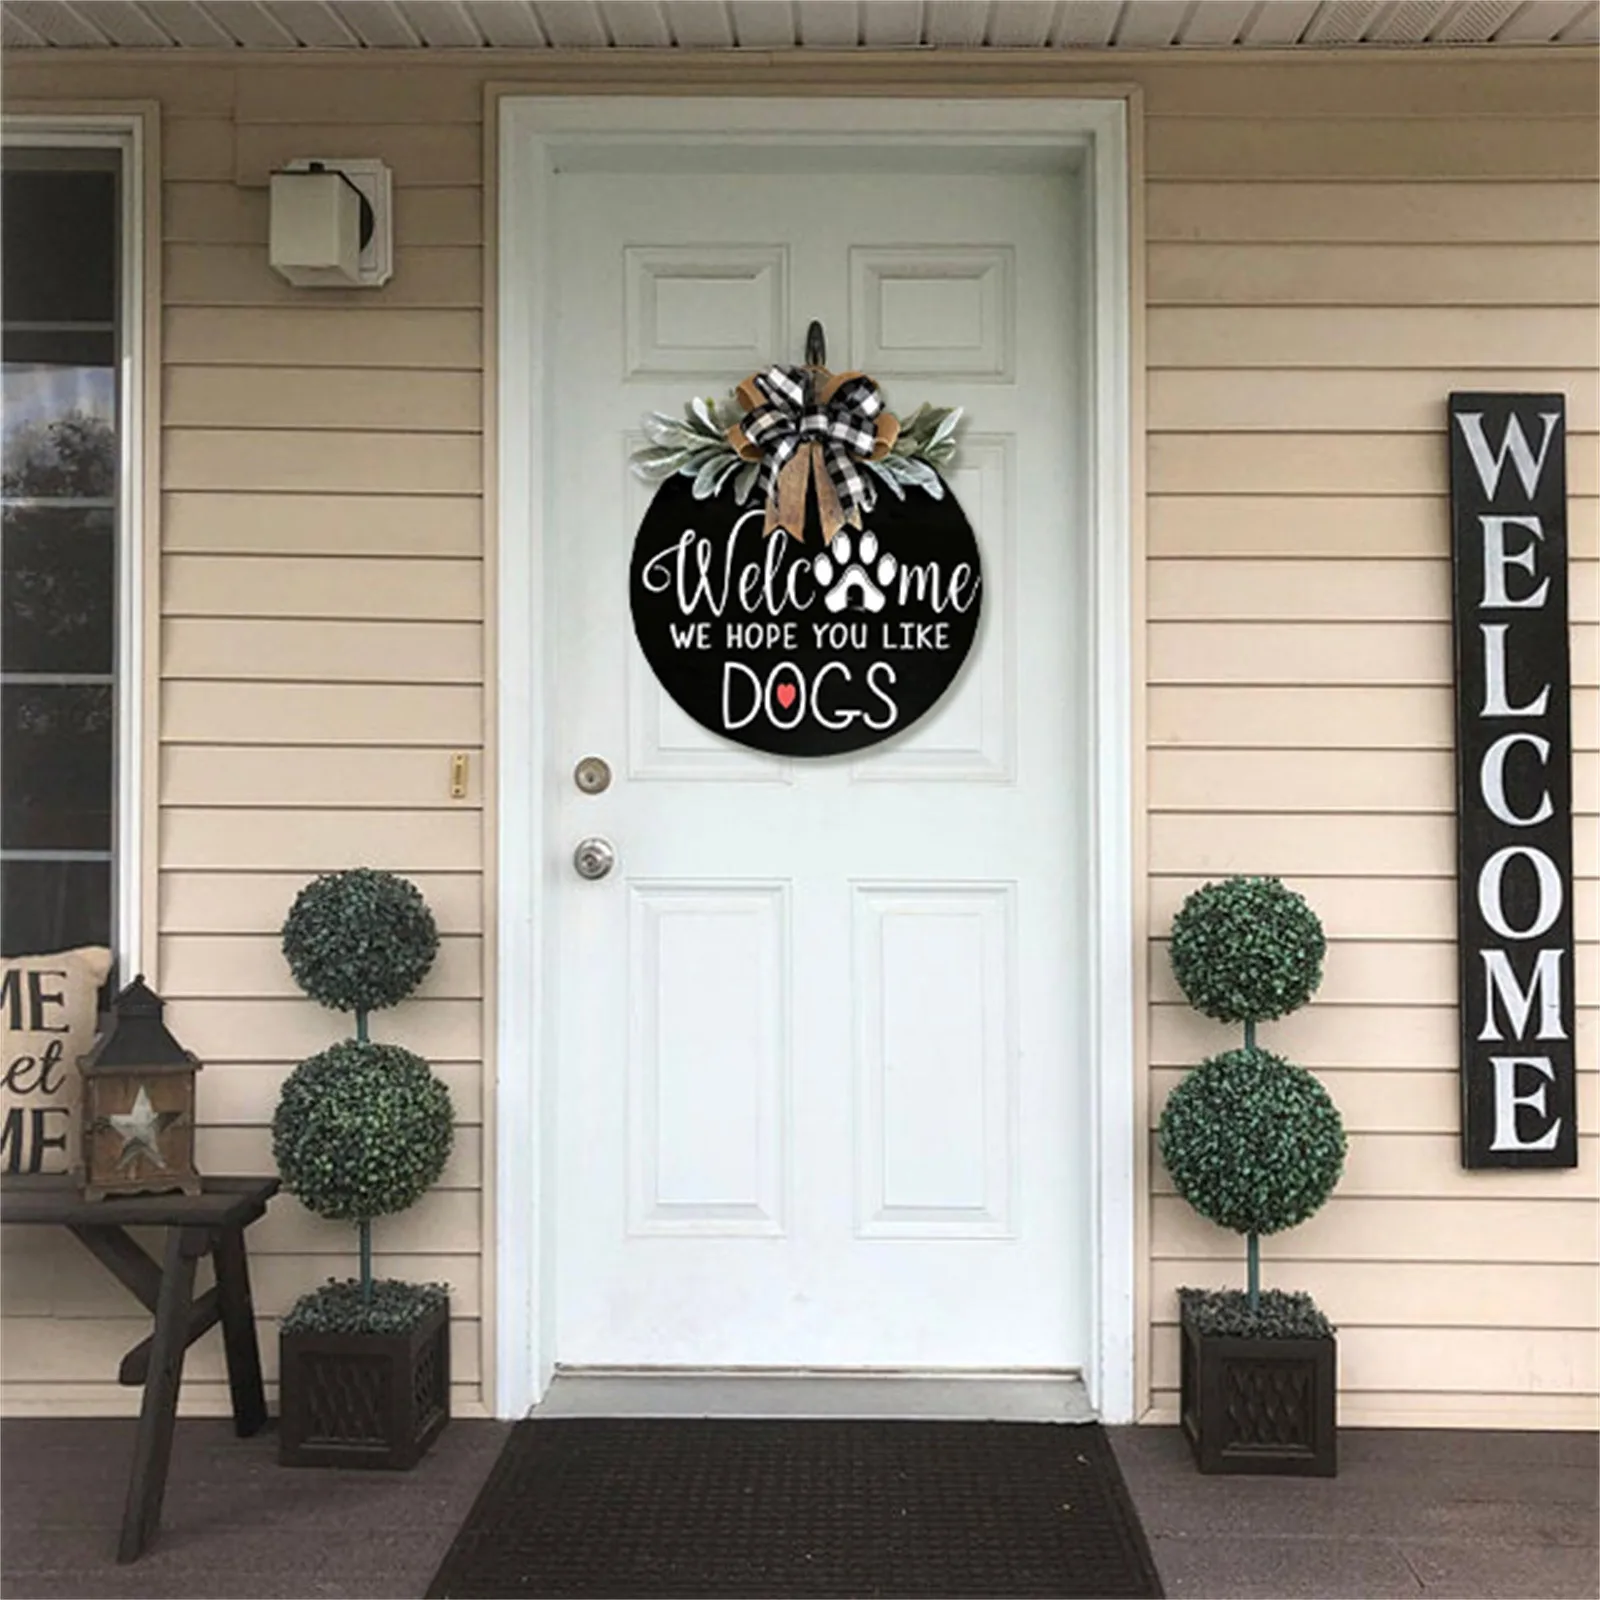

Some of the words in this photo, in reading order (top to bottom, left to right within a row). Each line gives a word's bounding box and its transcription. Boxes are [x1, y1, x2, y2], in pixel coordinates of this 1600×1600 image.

[642, 510, 981, 616] Welcme
[670, 623, 711, 649] WE
[727, 623, 797, 649] HOPE
[813, 623, 867, 649] YOU
[884, 623, 950, 649] LIKE
[722, 661, 898, 730] DOGS
[1455, 412, 1568, 1152] WELCOME
